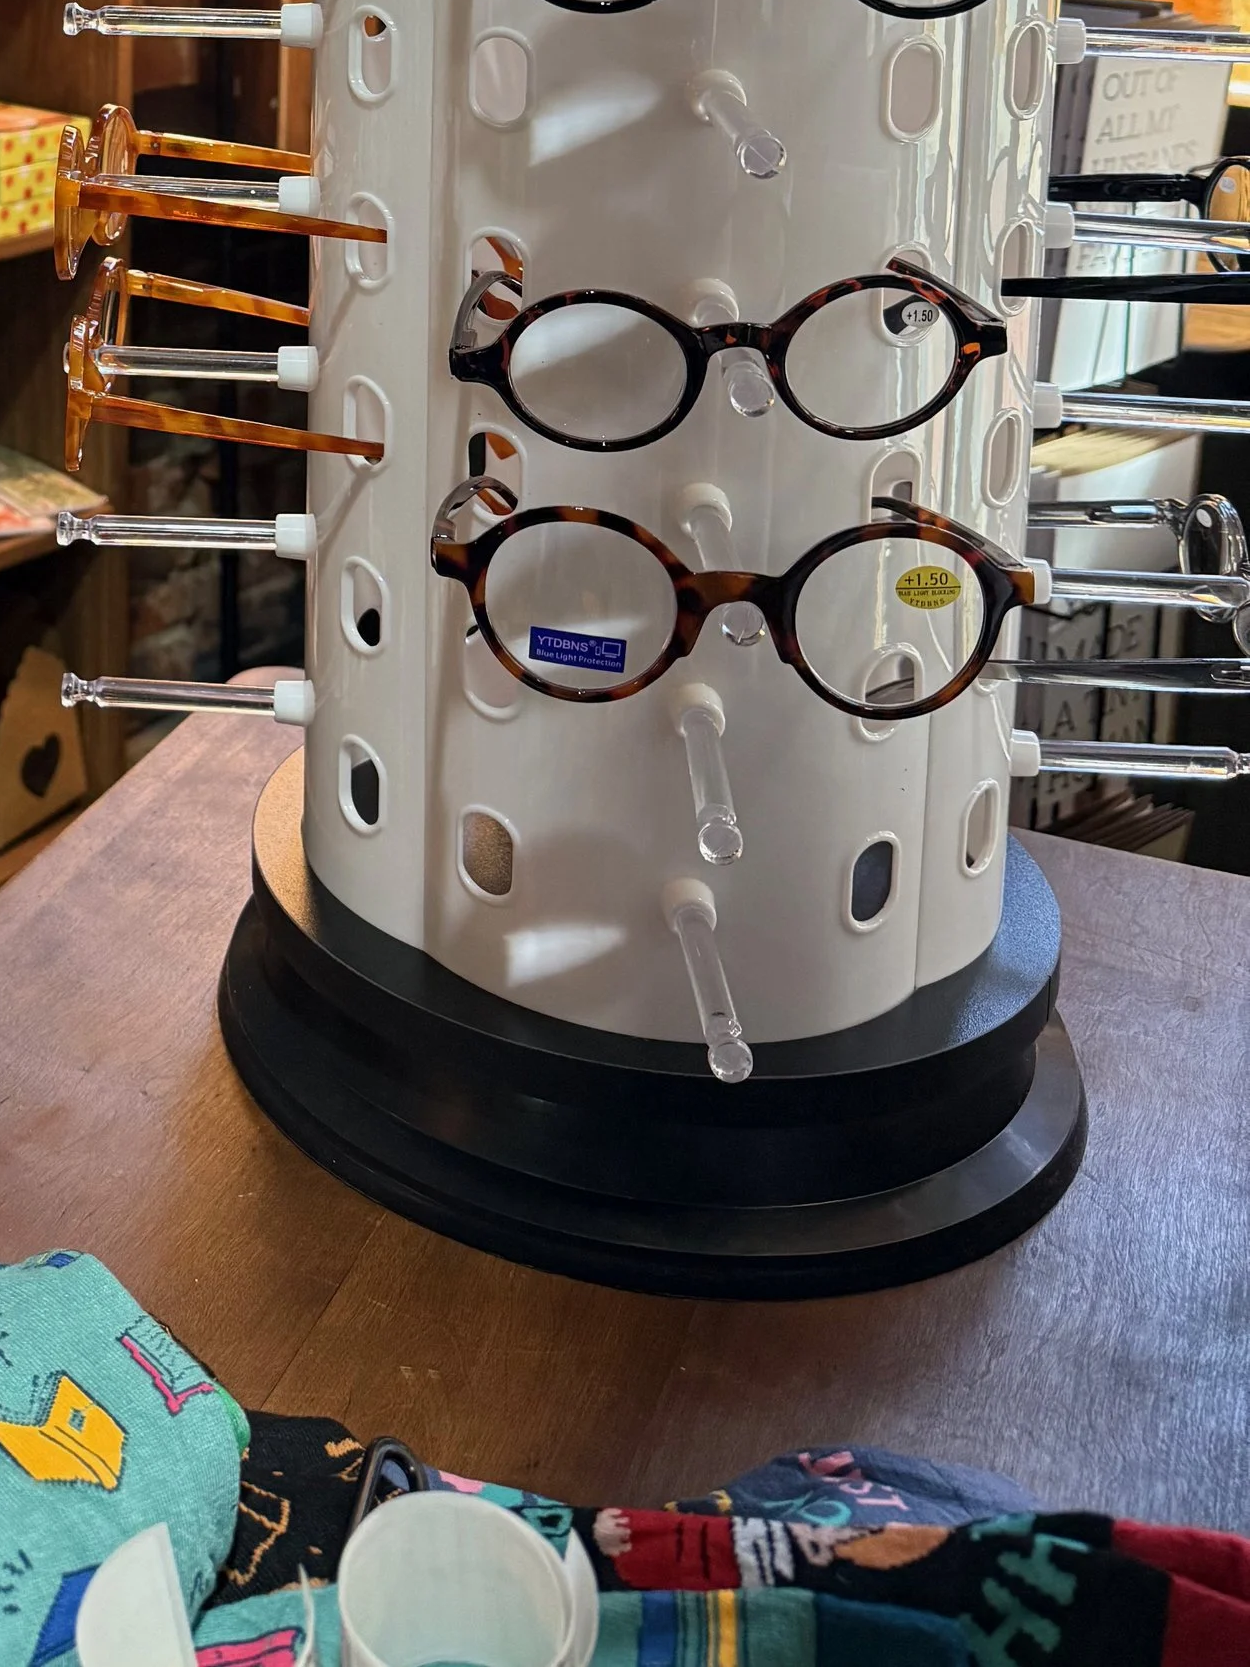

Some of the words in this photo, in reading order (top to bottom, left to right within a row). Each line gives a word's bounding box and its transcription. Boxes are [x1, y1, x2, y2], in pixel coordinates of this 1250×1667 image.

[906, 309, 933, 323] +1.50
[904, 572, 949, 587] +1.50
[536, 648, 555, 658] Blue
[555, 651, 577, 662] Light
[578, 655, 622, 668] Protection
